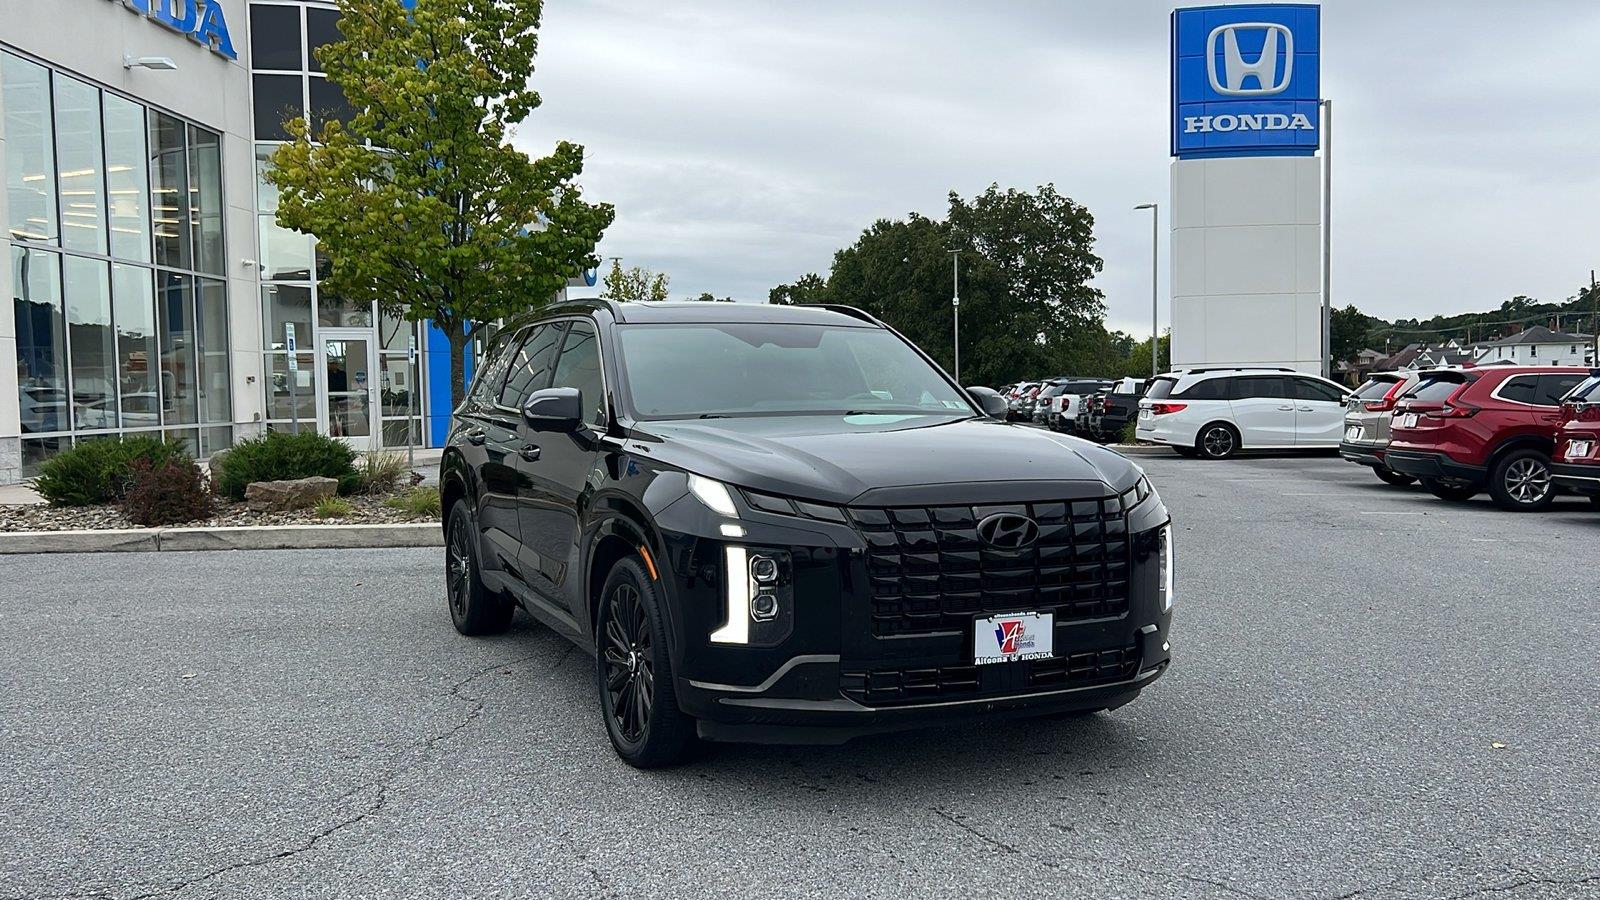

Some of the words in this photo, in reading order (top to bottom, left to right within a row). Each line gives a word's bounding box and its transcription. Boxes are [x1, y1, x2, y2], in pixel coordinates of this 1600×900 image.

[125, 0, 238, 60] DA
[1184, 113, 1315, 133] HONDA
[975, 656, 1008, 665] Altoona
[1021, 652, 1054, 660] HONDA
